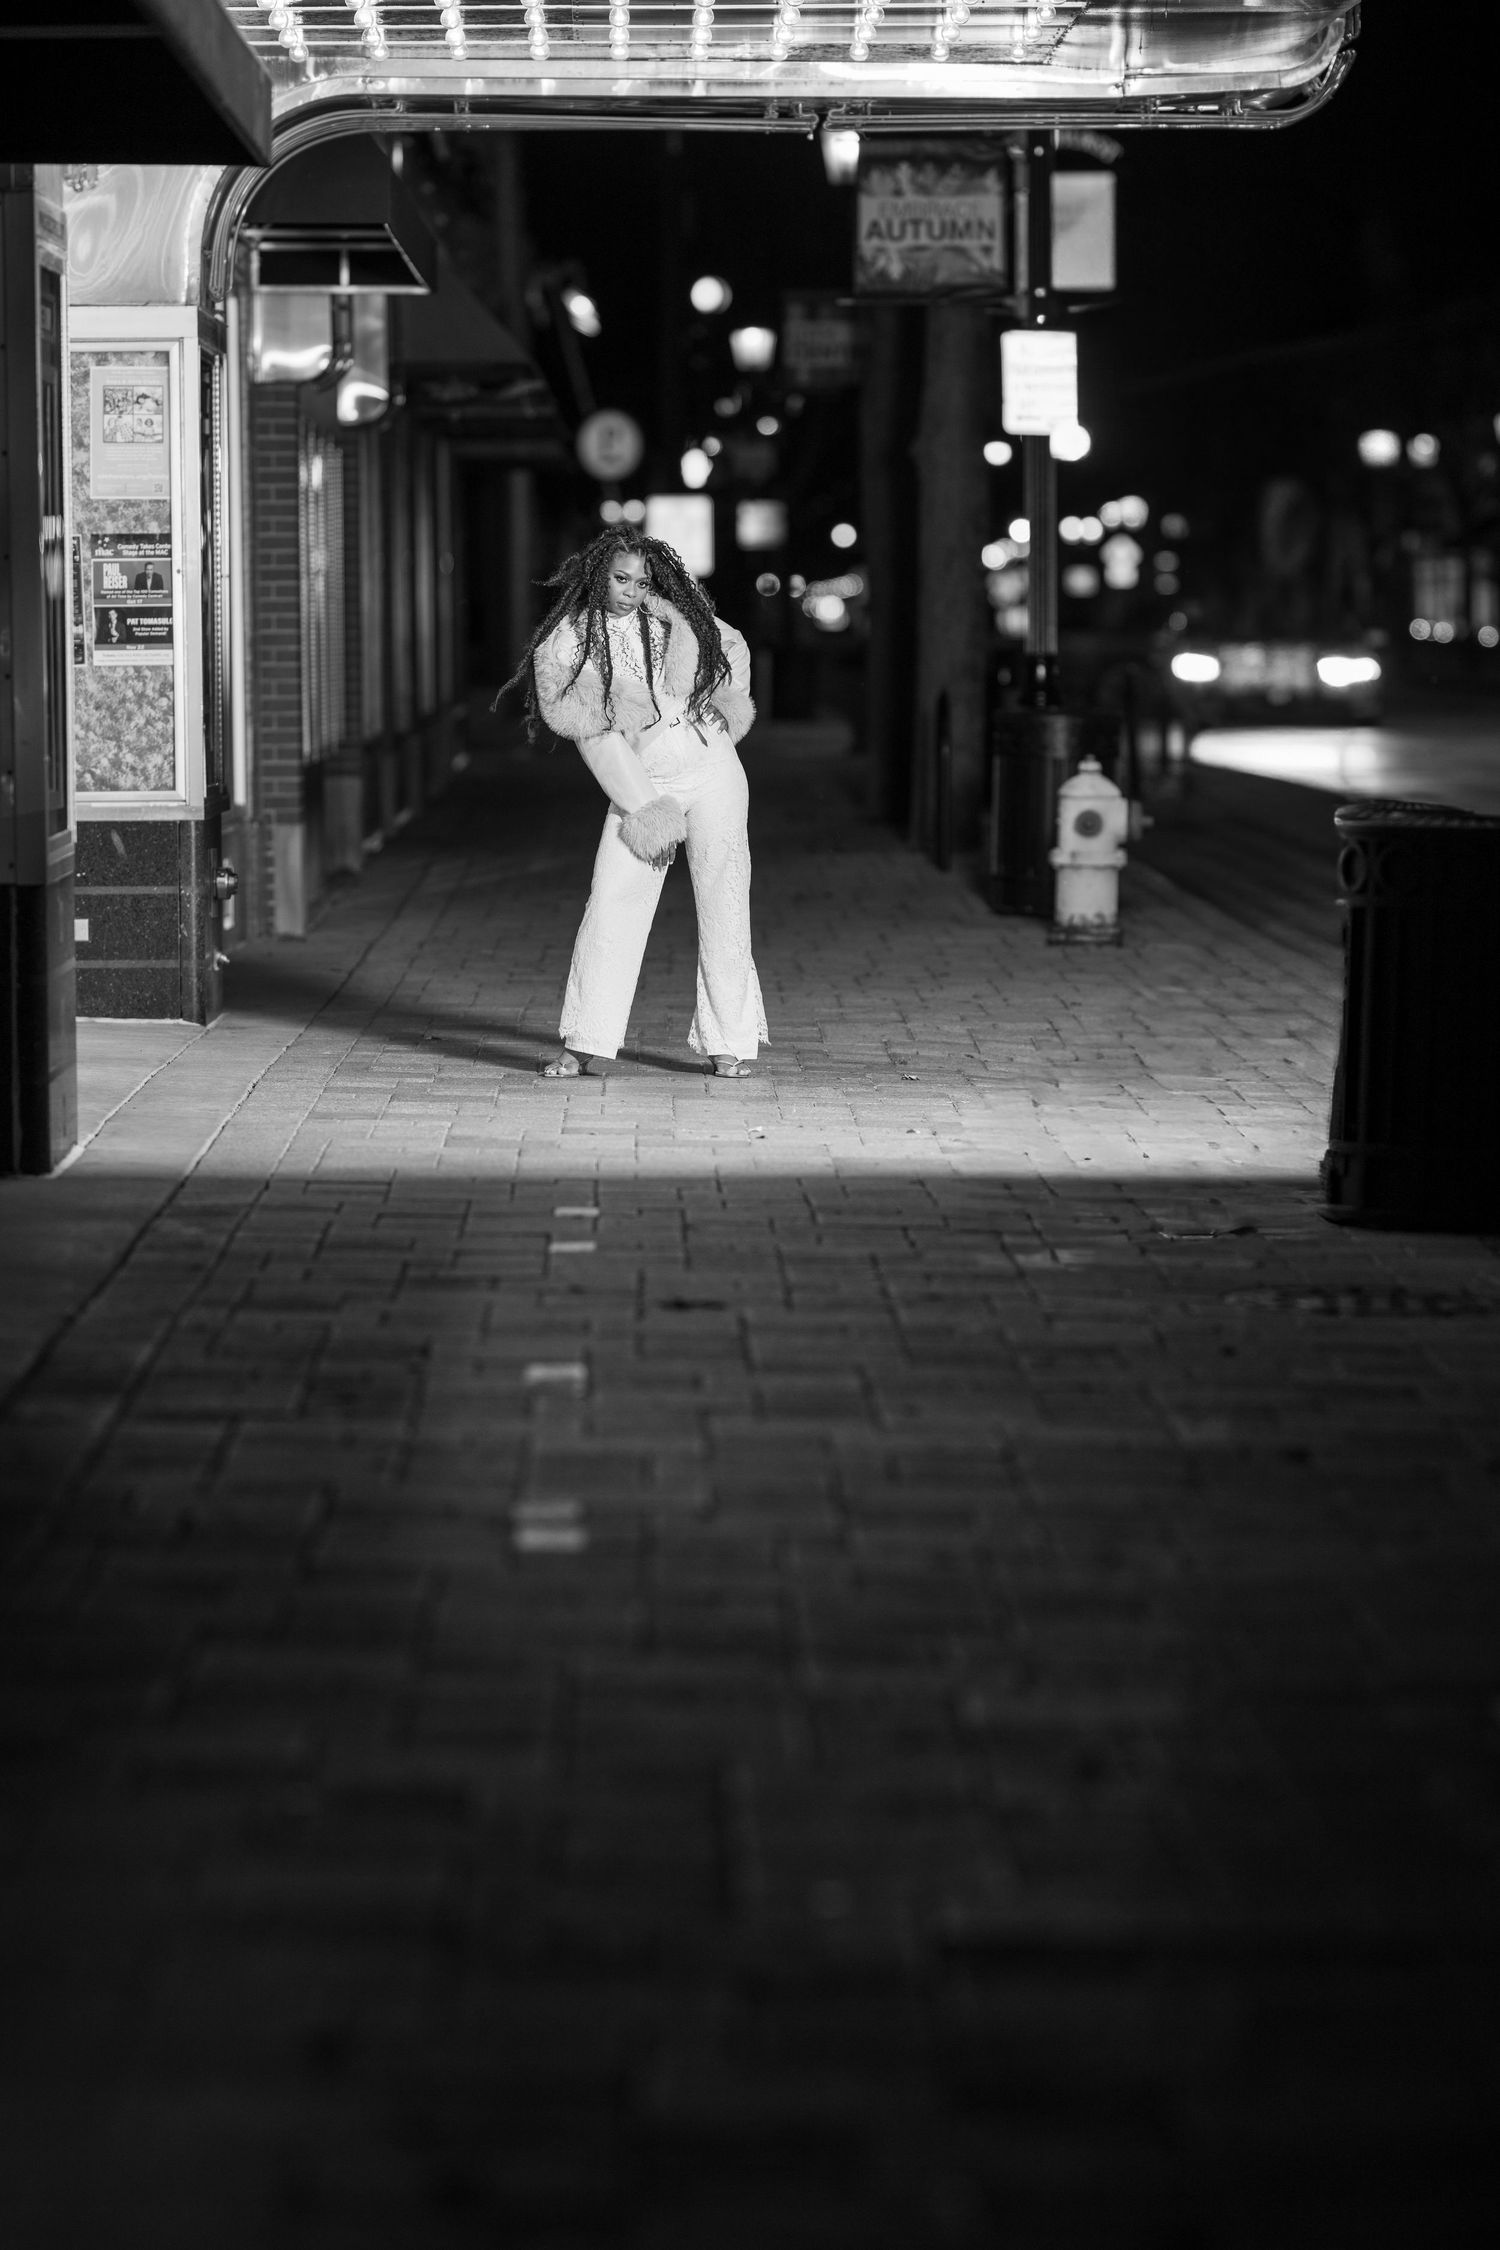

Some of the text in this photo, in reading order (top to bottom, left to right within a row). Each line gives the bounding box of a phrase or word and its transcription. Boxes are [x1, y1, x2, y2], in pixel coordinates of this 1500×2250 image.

[865, 218, 995, 241] AUTUMN
[103, 563, 121, 576] PAUL
[103, 575, 128, 589] REISER
